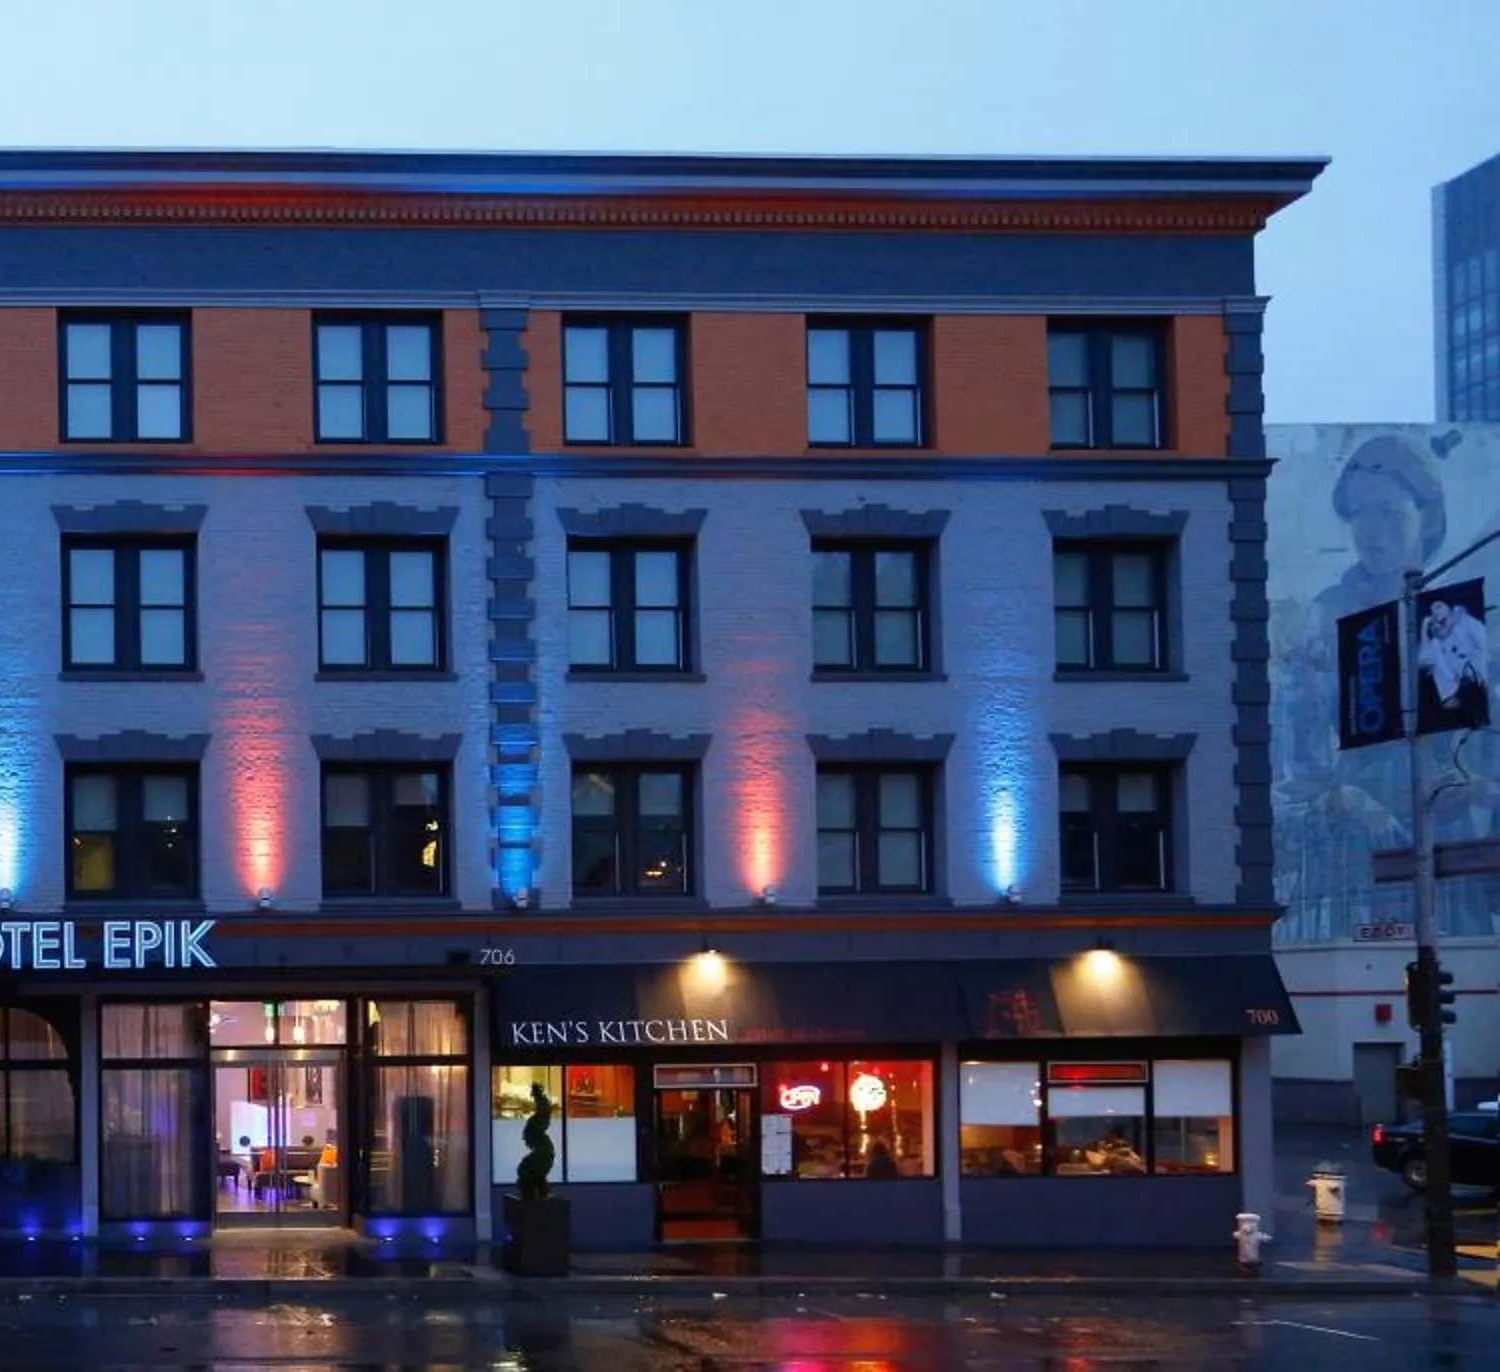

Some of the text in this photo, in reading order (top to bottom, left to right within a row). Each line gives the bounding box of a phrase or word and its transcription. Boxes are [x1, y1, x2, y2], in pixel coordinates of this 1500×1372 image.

[1357, 617, 1386, 735] OPERA
[103, 919, 217, 969] EPIK
[480, 949, 515, 965] 706
[1245, 1009, 1279, 1025] 700
[512, 1022, 589, 1044] KEN'S
[599, 1019, 729, 1043] KITCHEN
